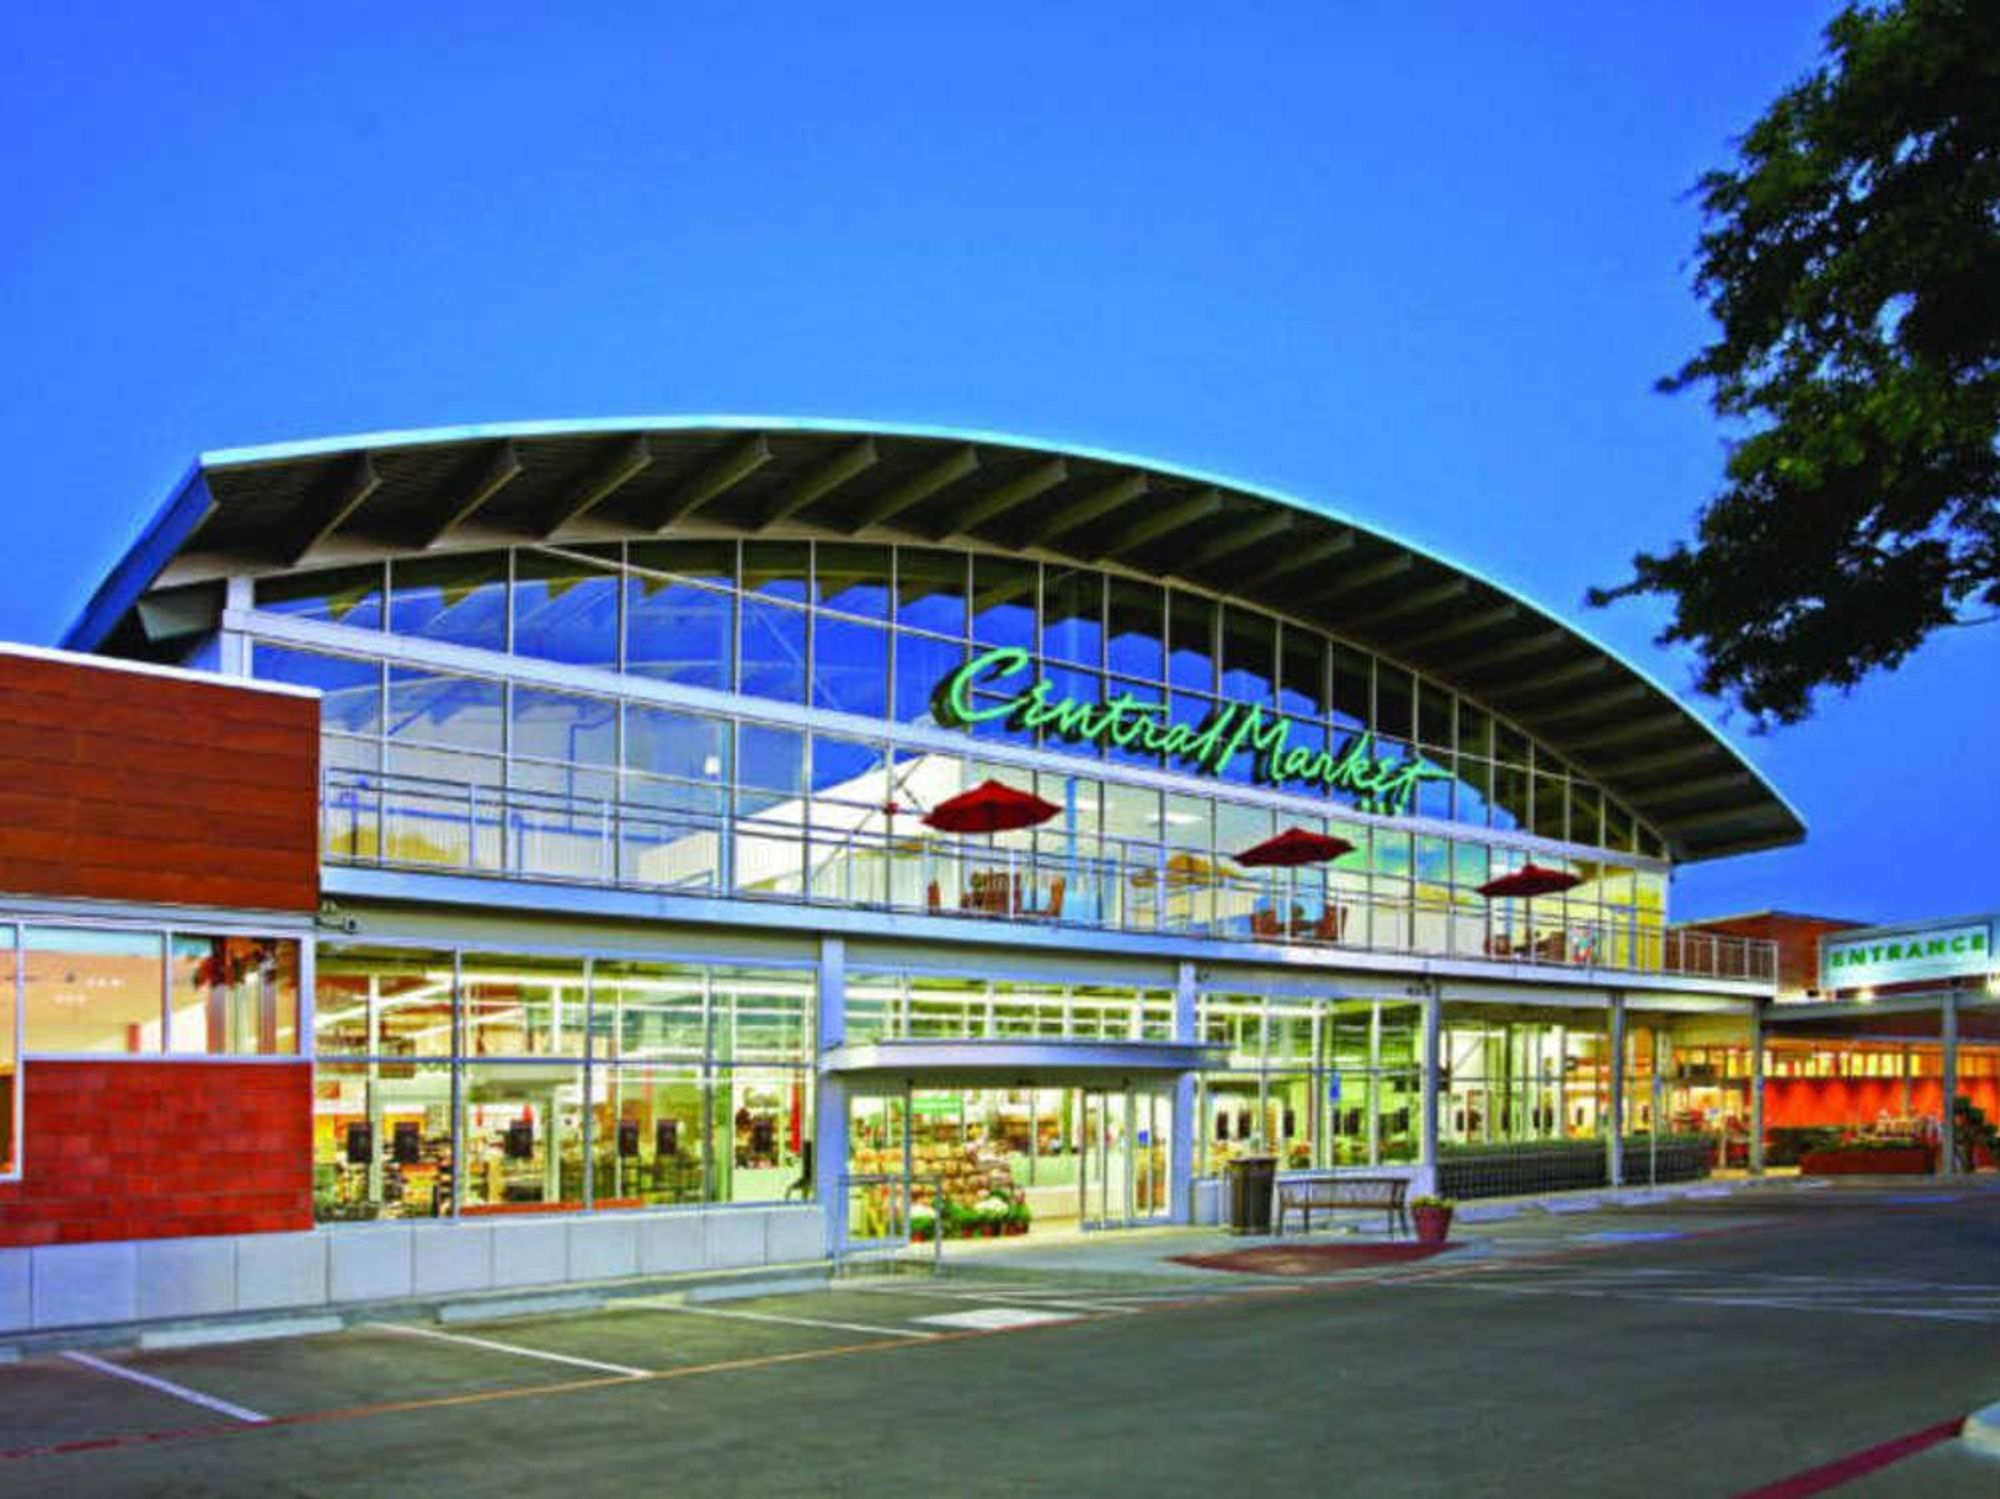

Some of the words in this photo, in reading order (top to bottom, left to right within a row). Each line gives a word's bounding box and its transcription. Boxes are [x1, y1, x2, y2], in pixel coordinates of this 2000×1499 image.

[951, 646, 1237, 761] Central
[1215, 703, 1455, 809] Market
[1831, 934, 1985, 967] ENTRANCE
